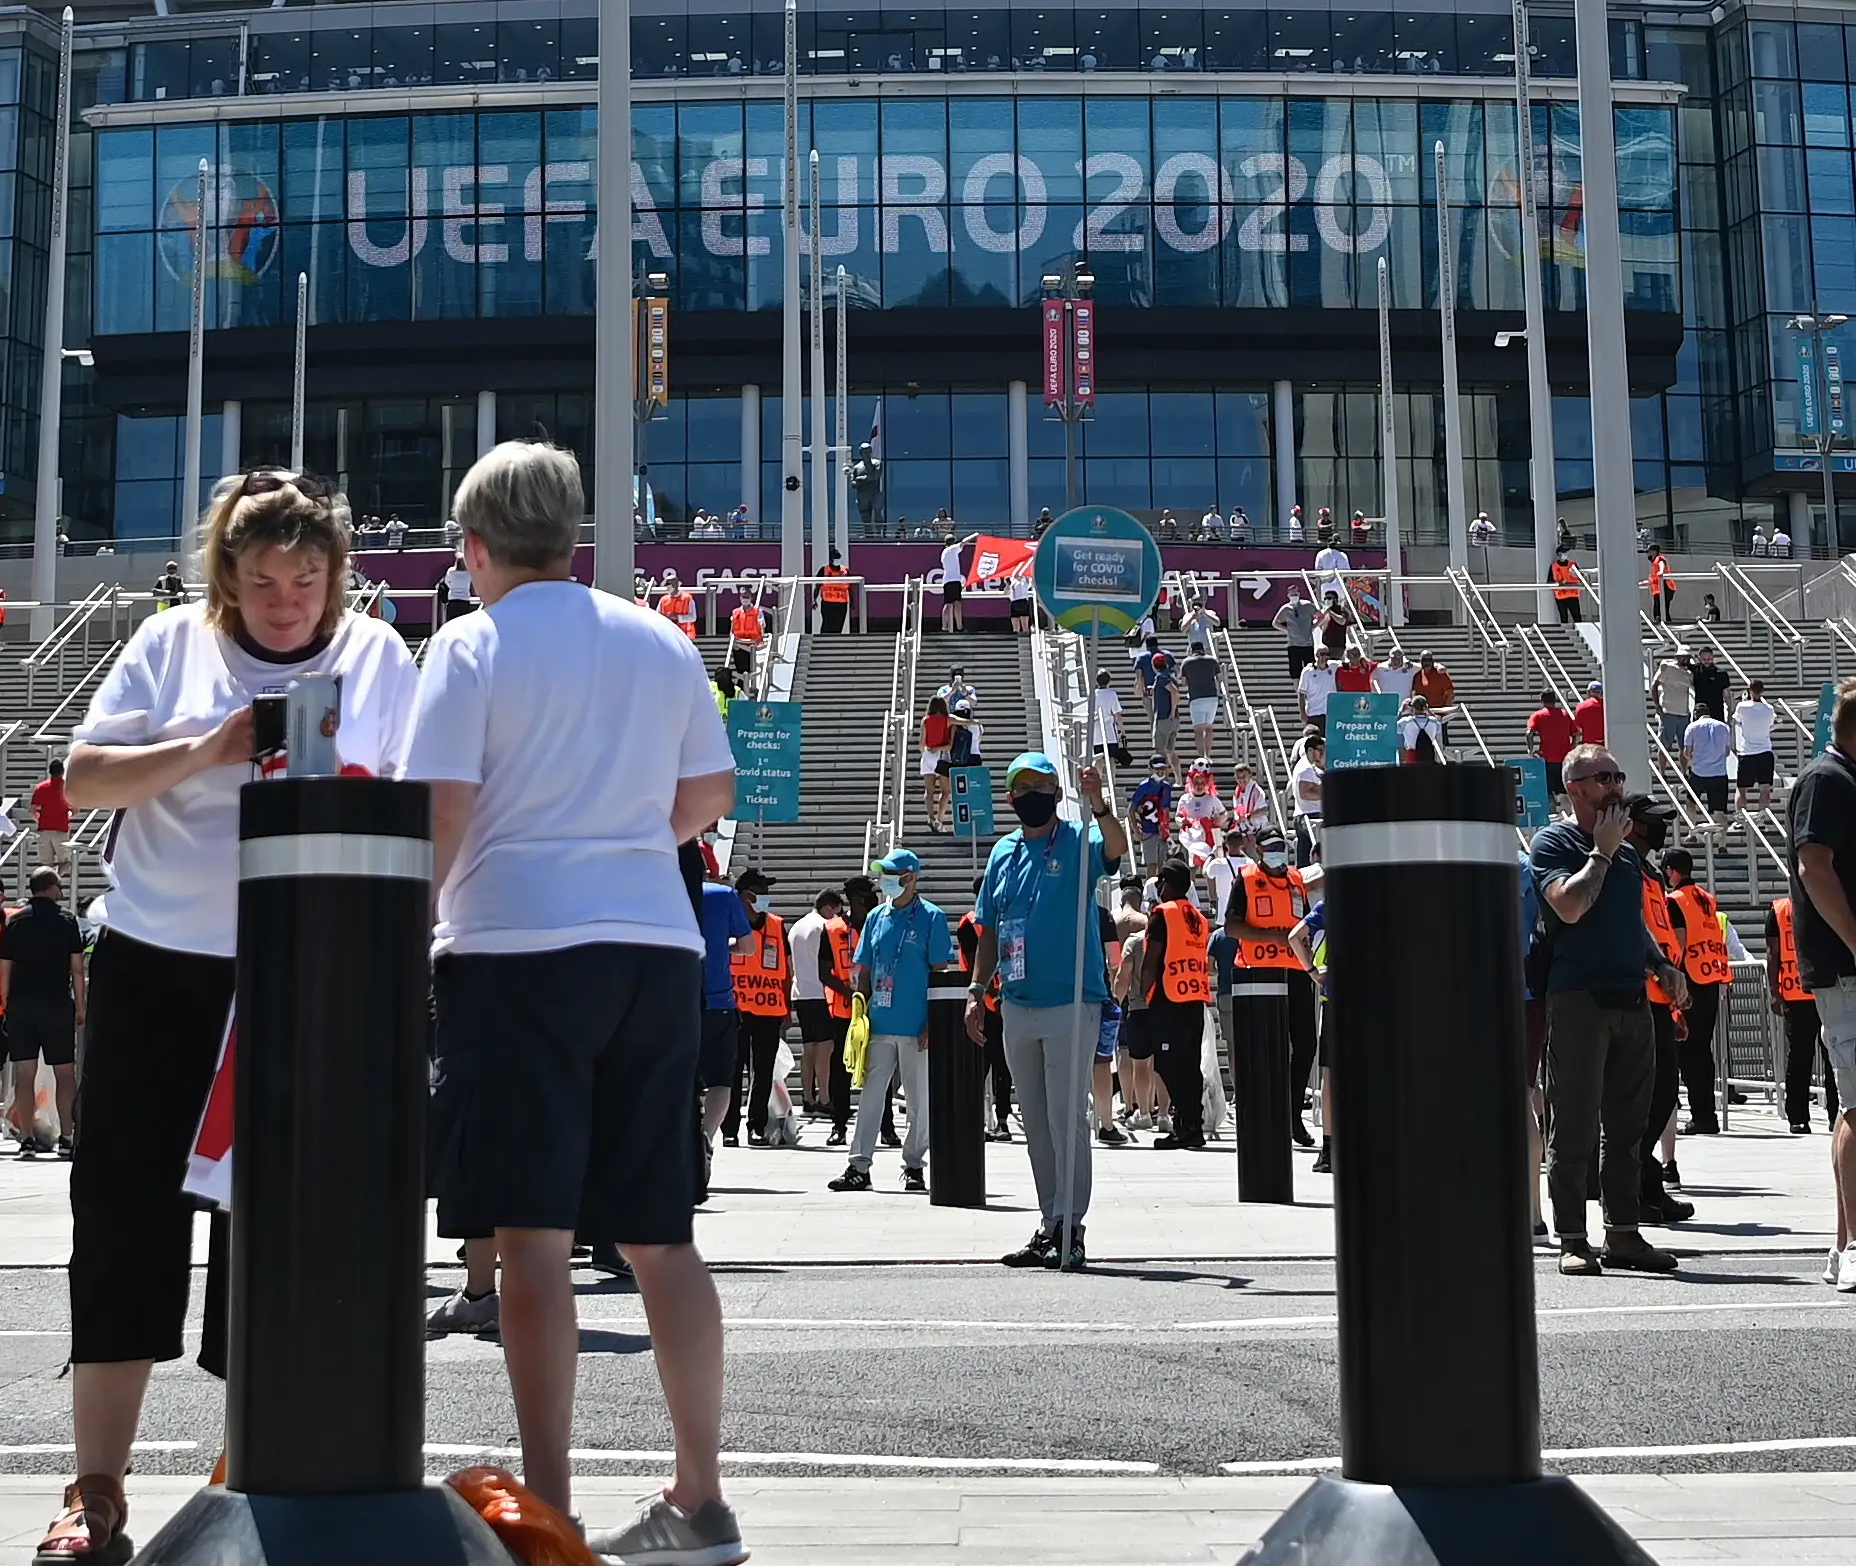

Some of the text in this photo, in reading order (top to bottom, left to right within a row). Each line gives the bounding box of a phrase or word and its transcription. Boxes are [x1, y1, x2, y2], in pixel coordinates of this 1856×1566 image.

[347, 159, 674, 268] UEFA
[700, 151, 1047, 257] EURO
[1074, 151, 1392, 255] 2020
[1049, 329, 1058, 395] UEFA EURO 2020
[1073, 550, 1125, 564] Get ready
[1073, 561, 1125, 574] for COVID
[696, 567, 780, 594] EAST
[1079, 574, 1118, 586] checks!
[1335, 721, 1388, 731] Prepare for
[737, 729, 791, 740] Prepare for
[746, 740, 781, 750] checks:
[734, 767, 792, 778] Covid status
[745, 795, 778, 805] Tickets
